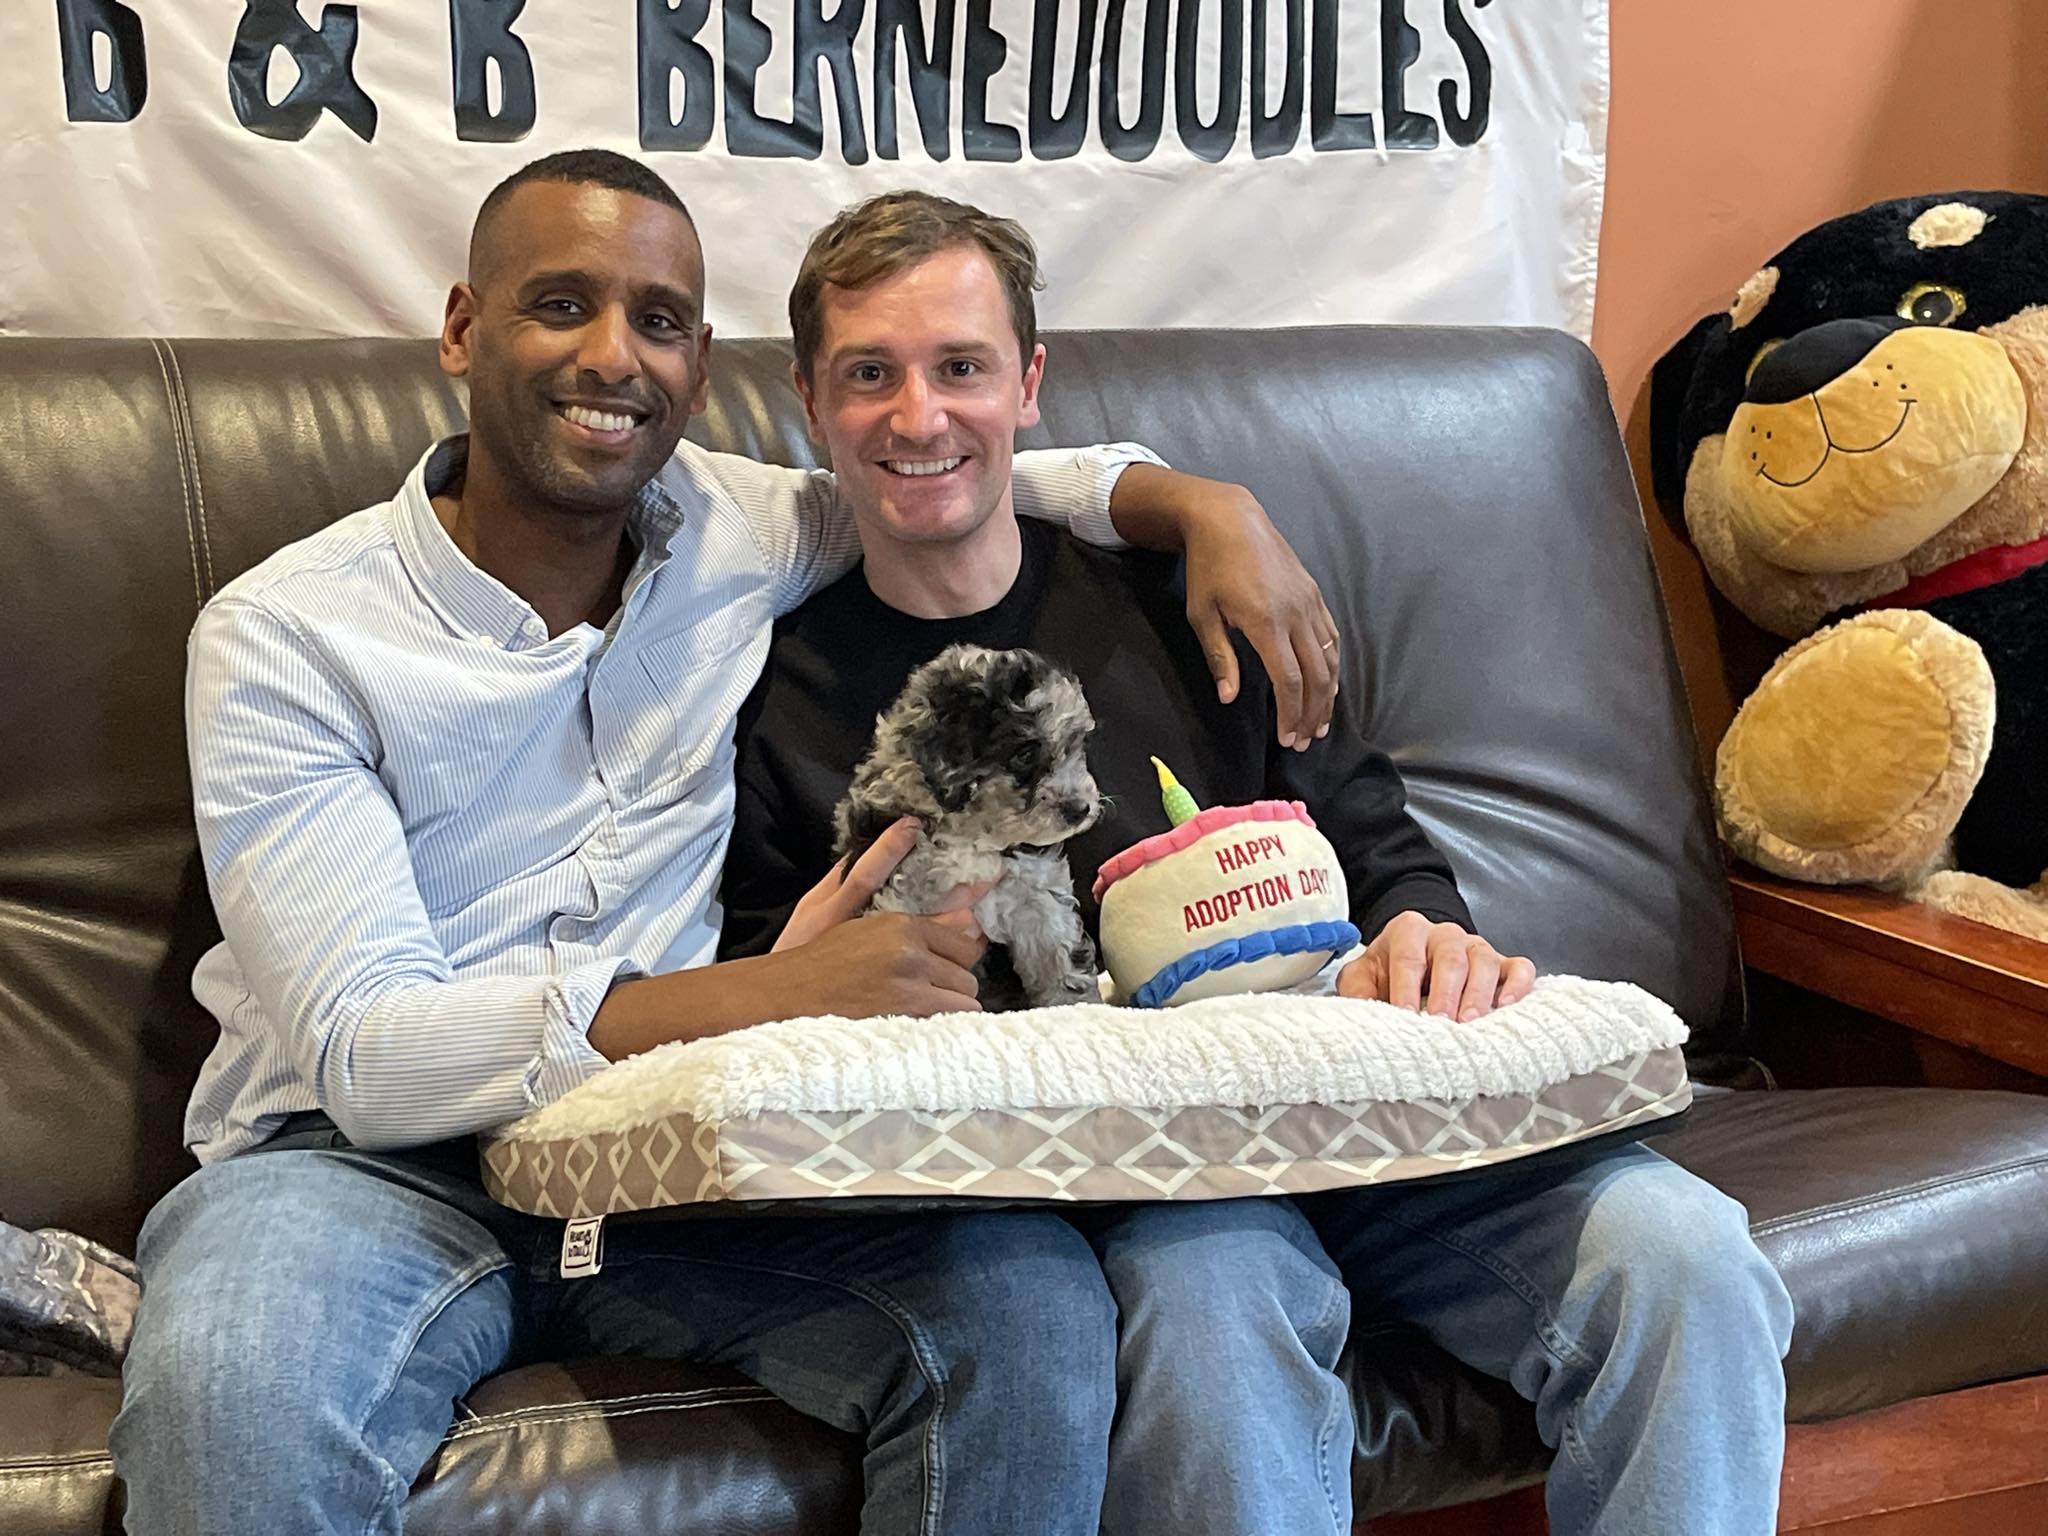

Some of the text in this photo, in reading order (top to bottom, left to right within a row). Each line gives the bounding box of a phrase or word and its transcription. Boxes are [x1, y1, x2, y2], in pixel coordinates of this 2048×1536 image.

[228, 0, 377, 143] &
[450, 0, 536, 143] B
[637, 0, 1492, 164] BERNEDOODLES
[1215, 834, 1286, 874] HAPPY
[1183, 874, 1293, 933] ADOPTION
